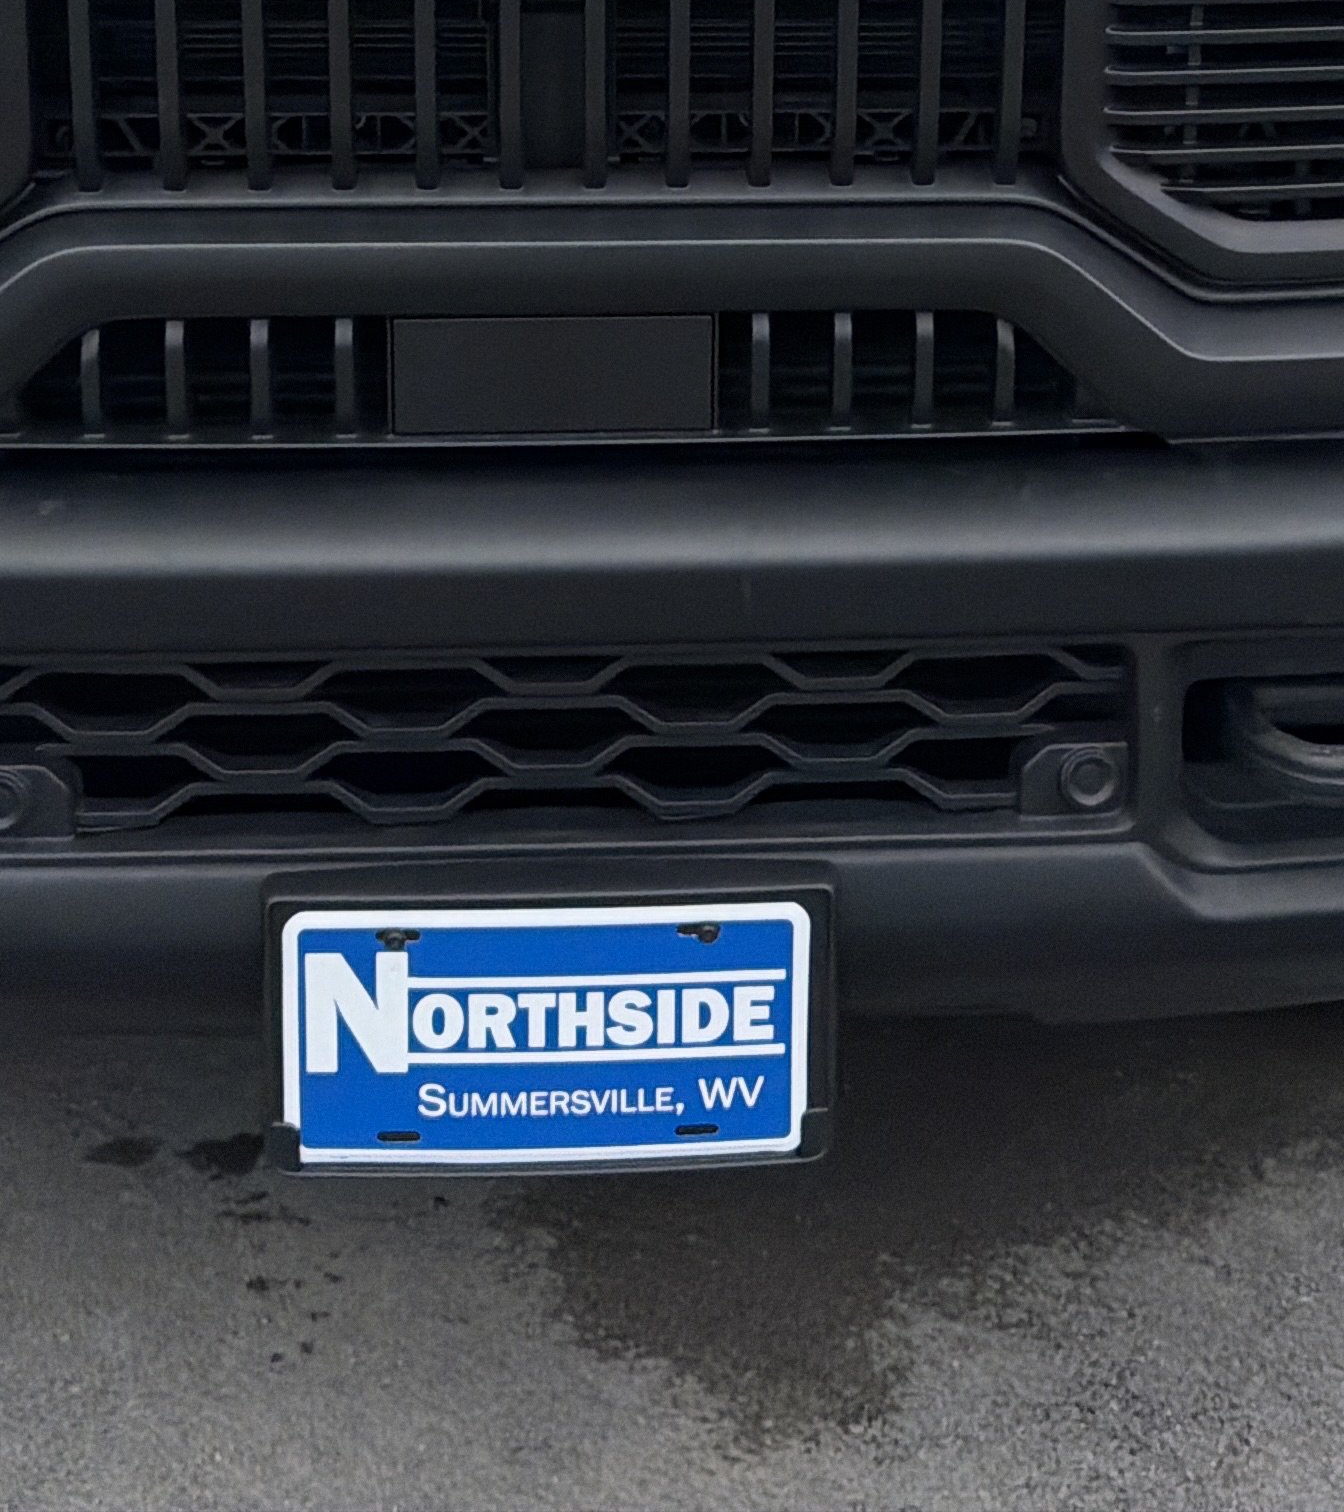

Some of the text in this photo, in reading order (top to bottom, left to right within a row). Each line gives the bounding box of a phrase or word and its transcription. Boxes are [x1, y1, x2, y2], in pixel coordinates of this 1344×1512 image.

[305, 951, 776, 1074] NORTHSIDE
[418, 1075, 765, 1119] SUMMERSVILLE, WV
